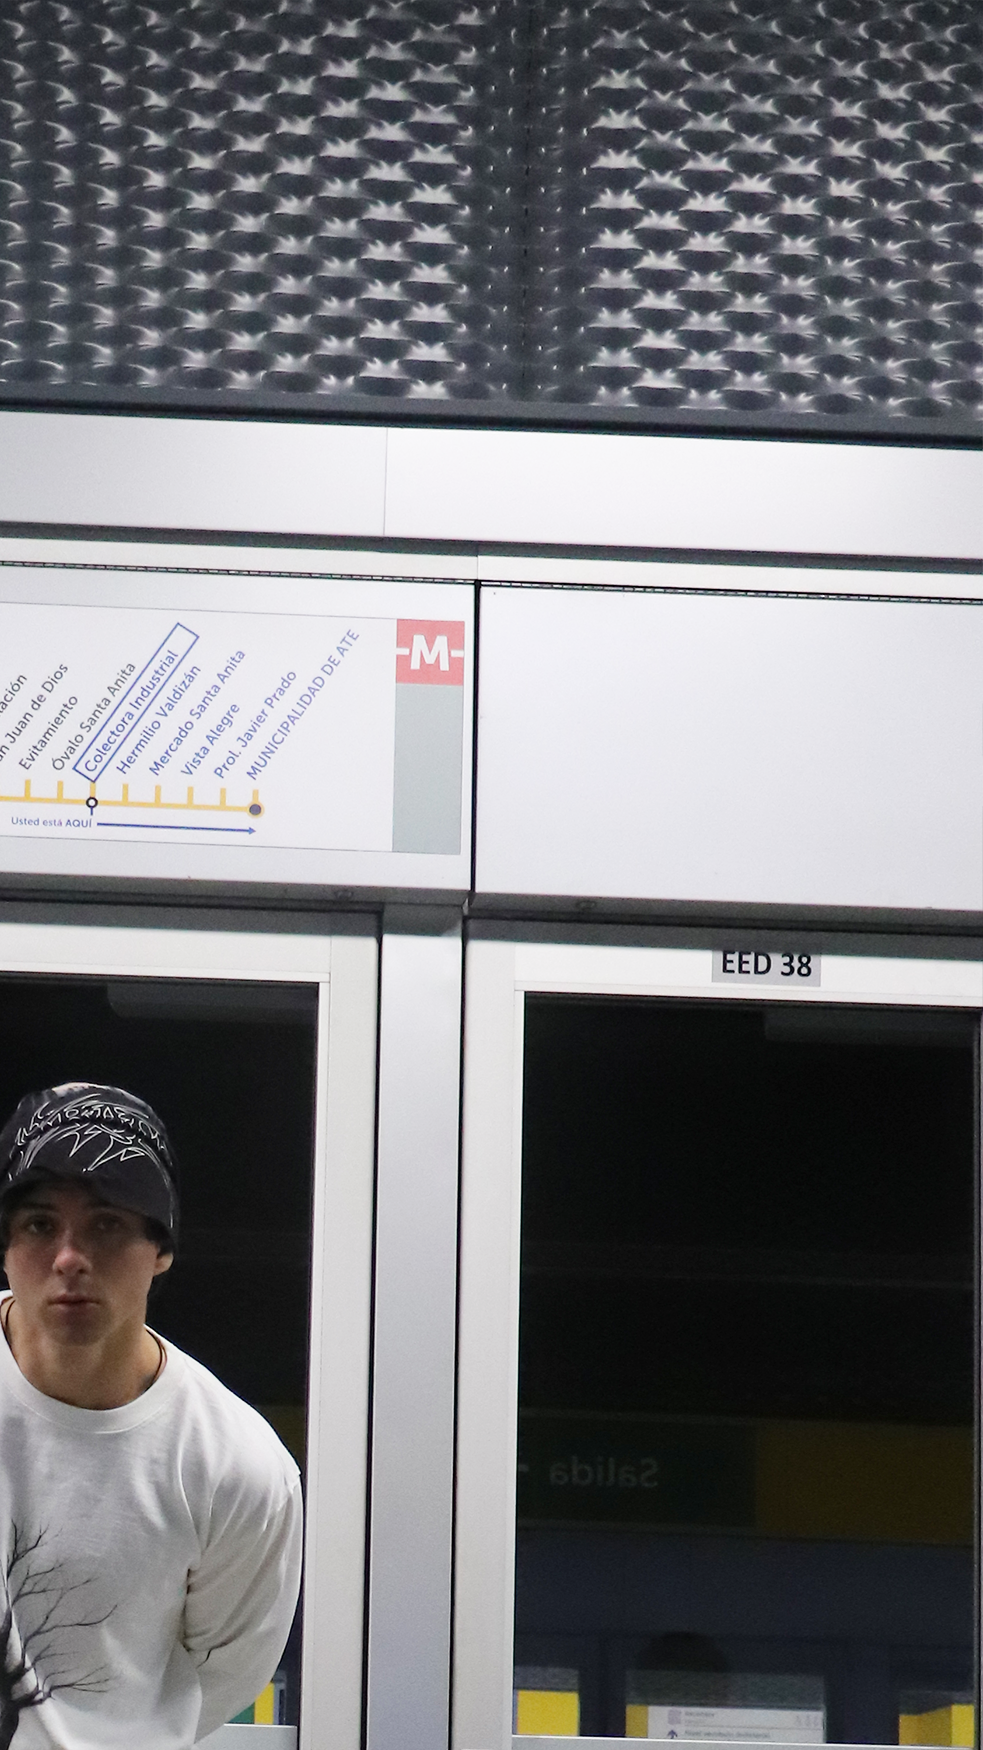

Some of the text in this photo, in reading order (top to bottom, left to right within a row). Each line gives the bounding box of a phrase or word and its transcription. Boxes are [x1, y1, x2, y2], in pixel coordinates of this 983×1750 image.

[410, 634, 449, 671] M
[4, 712, 34, 744] Juan
[31, 694, 47, 711] de
[41, 664, 68, 693] Dios
[18, 696, 78, 770] Evitamiento
[51, 663, 136, 771] Óvalo Santa Anita
[84, 649, 179, 772] Colectora Industrial
[116, 666, 201, 775] Hermilio Valdizán
[149, 651, 245, 776] Mercado Santa Anita
[180, 704, 240, 775] Vista Alegre
[213, 671, 296, 779] Prol. Javier Prado
[246, 629, 359, 781] MUNICIPALIDAD DE ATE
[11, 816, 92, 829] Usted está AQUÍ
[722, 950, 812, 977] EED 38
